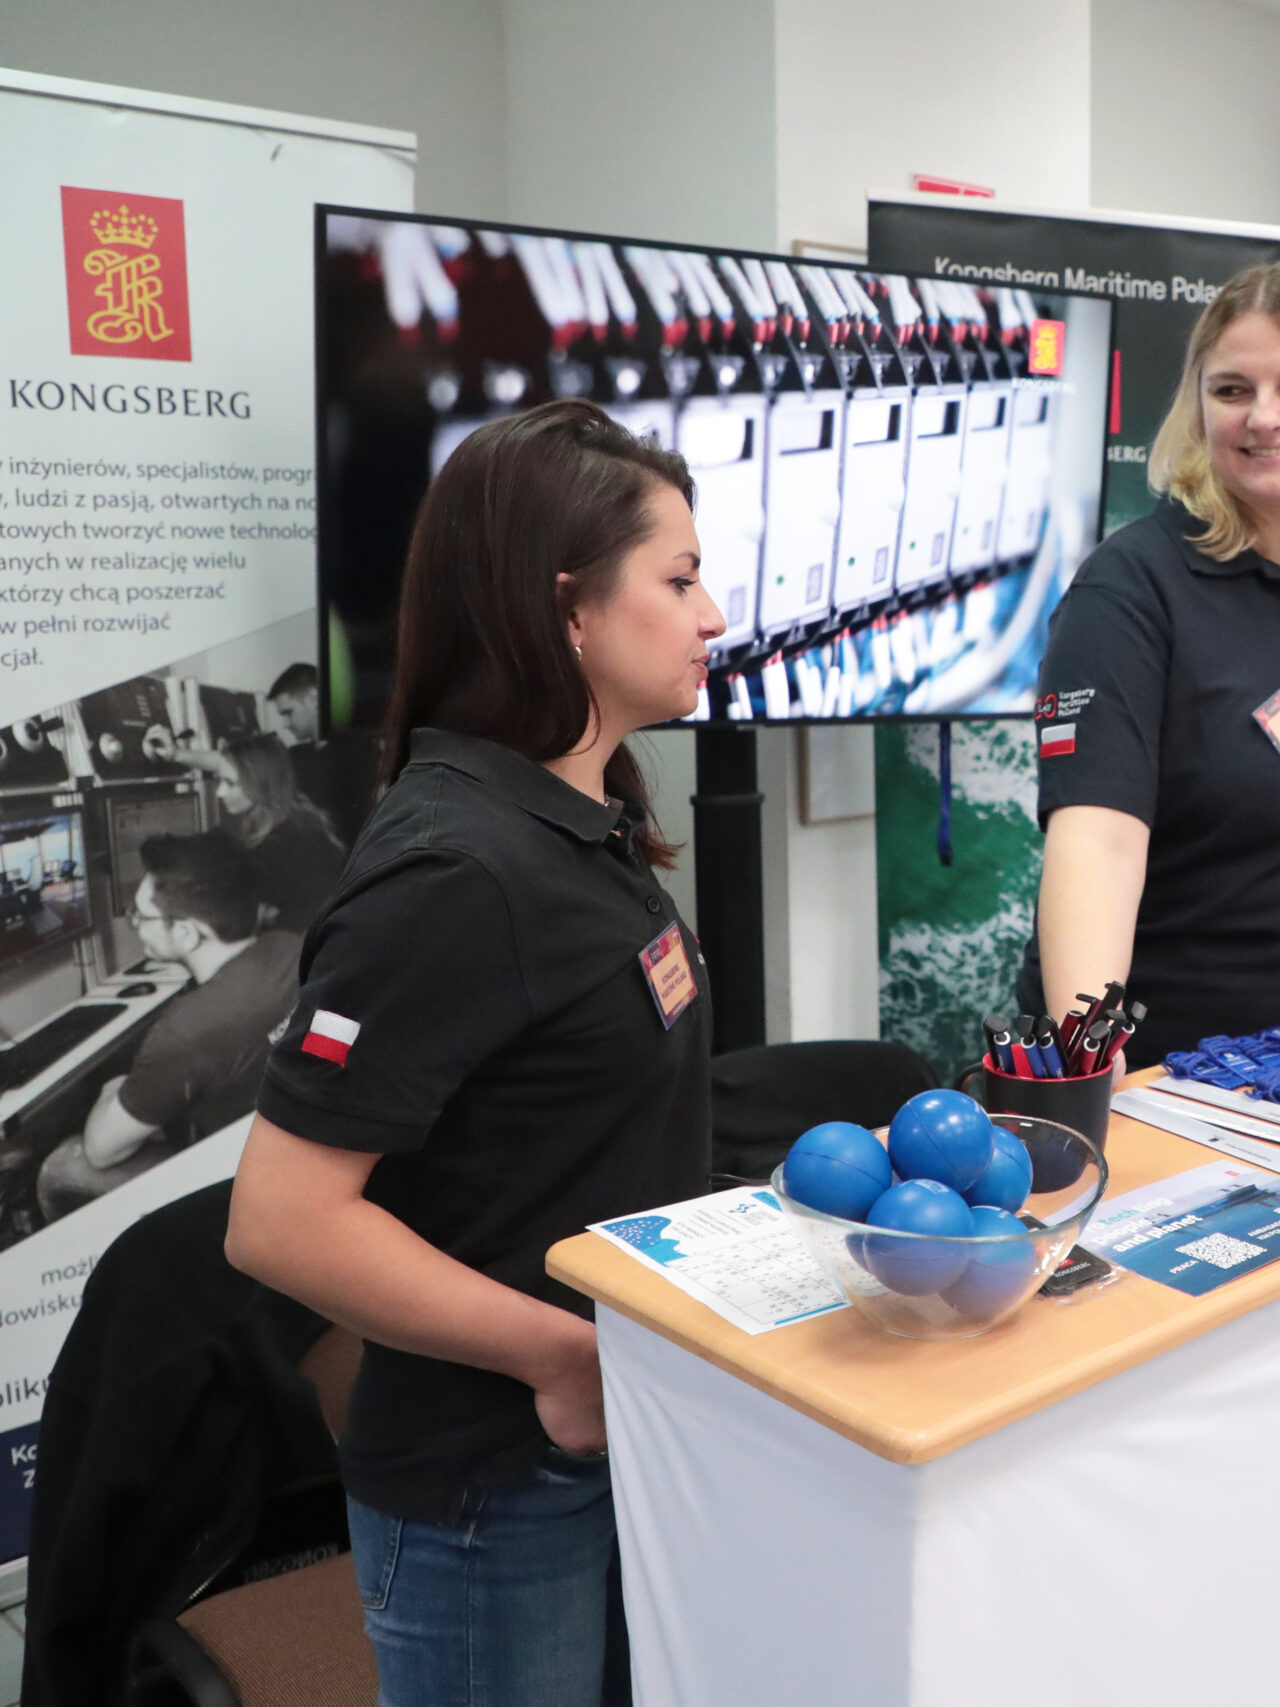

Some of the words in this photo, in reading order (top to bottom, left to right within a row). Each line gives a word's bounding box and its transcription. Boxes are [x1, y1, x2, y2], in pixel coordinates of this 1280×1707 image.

[1064, 266, 1167, 300] Maritime
[9, 378, 252, 420] KONGSBERG
[9, 457, 132, 481] inżynierów,
[136, 461, 259, 484] specjalistów,
[15, 488, 69, 509] ludzi
[74, 493, 86, 508] z
[93, 491, 155, 513] pasją,
[161, 493, 263, 514] otwartych
[267, 496, 290, 511] na
[83, 523, 166, 544] tworzyć
[171, 525, 224, 539] nowe
[66, 557, 85, 570] w
[90, 552, 188, 574] realizację
[194, 552, 247, 570] wielu
[70, 584, 120, 605] chcą
[126, 582, 226, 605] poszerzać
[23, 615, 77, 638] pełni
[84, 613, 171, 636] rozwijać
[0, 648, 44, 671] cjał.
[1112, 1233, 1152, 1253] and
